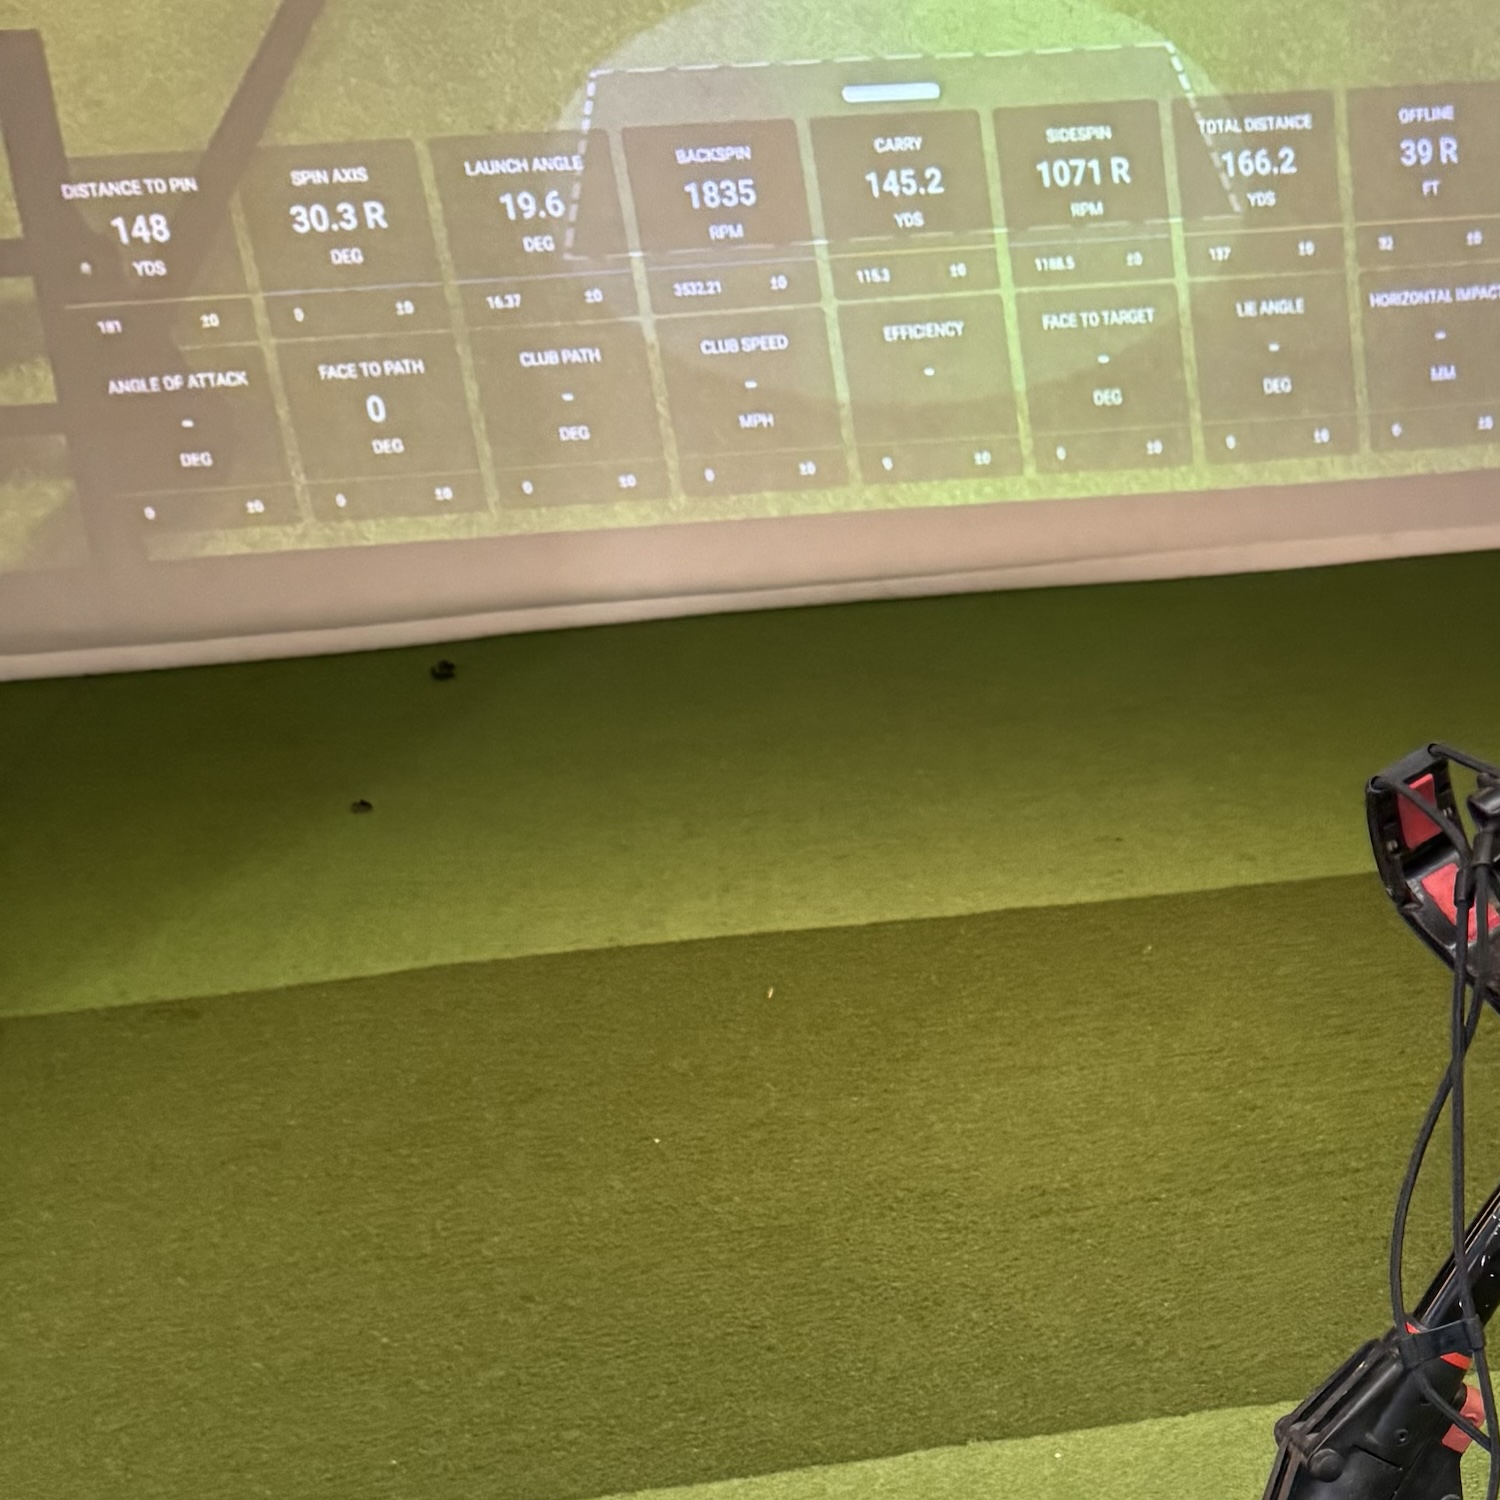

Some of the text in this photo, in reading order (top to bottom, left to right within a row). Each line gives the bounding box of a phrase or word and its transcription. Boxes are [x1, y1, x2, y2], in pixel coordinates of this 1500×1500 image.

[1199, 113, 1312, 135] TOTAL DISTANCE
[1398, 104, 1455, 124] OFFLINE
[1046, 125, 1112, 144] SIDESPIN
[675, 146, 752, 164] BACKSPIN
[873, 136, 922, 154] CARRY
[1400, 135, 1458, 166] 39 R
[464, 154, 584, 176] LAUNCH ANGLE
[1035, 156, 1132, 188] 1071 R
[1221, 146, 1297, 178] 166.2
[290, 166, 369, 186] SPIN AXIS
[865, 167, 945, 198] 145.2
[61, 177, 198, 200] DISTANCE TO PIN
[684, 178, 757, 210] 1835
[1421, 180, 1441, 196] FT
[499, 190, 565, 220] 19.6
[1246, 190, 1276, 207] YDS
[289, 201, 388, 233] 30.3 R
[1070, 201, 1104, 217] RPM
[111, 213, 170, 245] 148
[894, 211, 925, 228] YDS
[709, 224, 744, 240] RPM
[522, 235, 555, 253] DEG
[330, 248, 364, 265] DEG
[132, 260, 167, 277] YDS
[1369, 286, 1453, 308] HORIZONTAL
[1235, 297, 1304, 318] LIE ANGLE
[1041, 307, 1155, 331] FACE TO TARGET
[883, 321, 964, 342] EFFICIENCY
[700, 334, 789, 354] CLUB SPEED
[519, 348, 602, 368] CLUB PATH
[318, 358, 424, 380] FACE TO PATH
[108, 371, 249, 395] ANGLE OF ATTACK
[1263, 376, 1292, 394] DEG
[1092, 388, 1123, 406] DEG
[366, 394, 387, 423] 0
[738, 412, 774, 428] MPH
[558, 425, 590, 441] DEG
[371, 438, 405, 454] DEG
[179, 452, 213, 468] DEG
